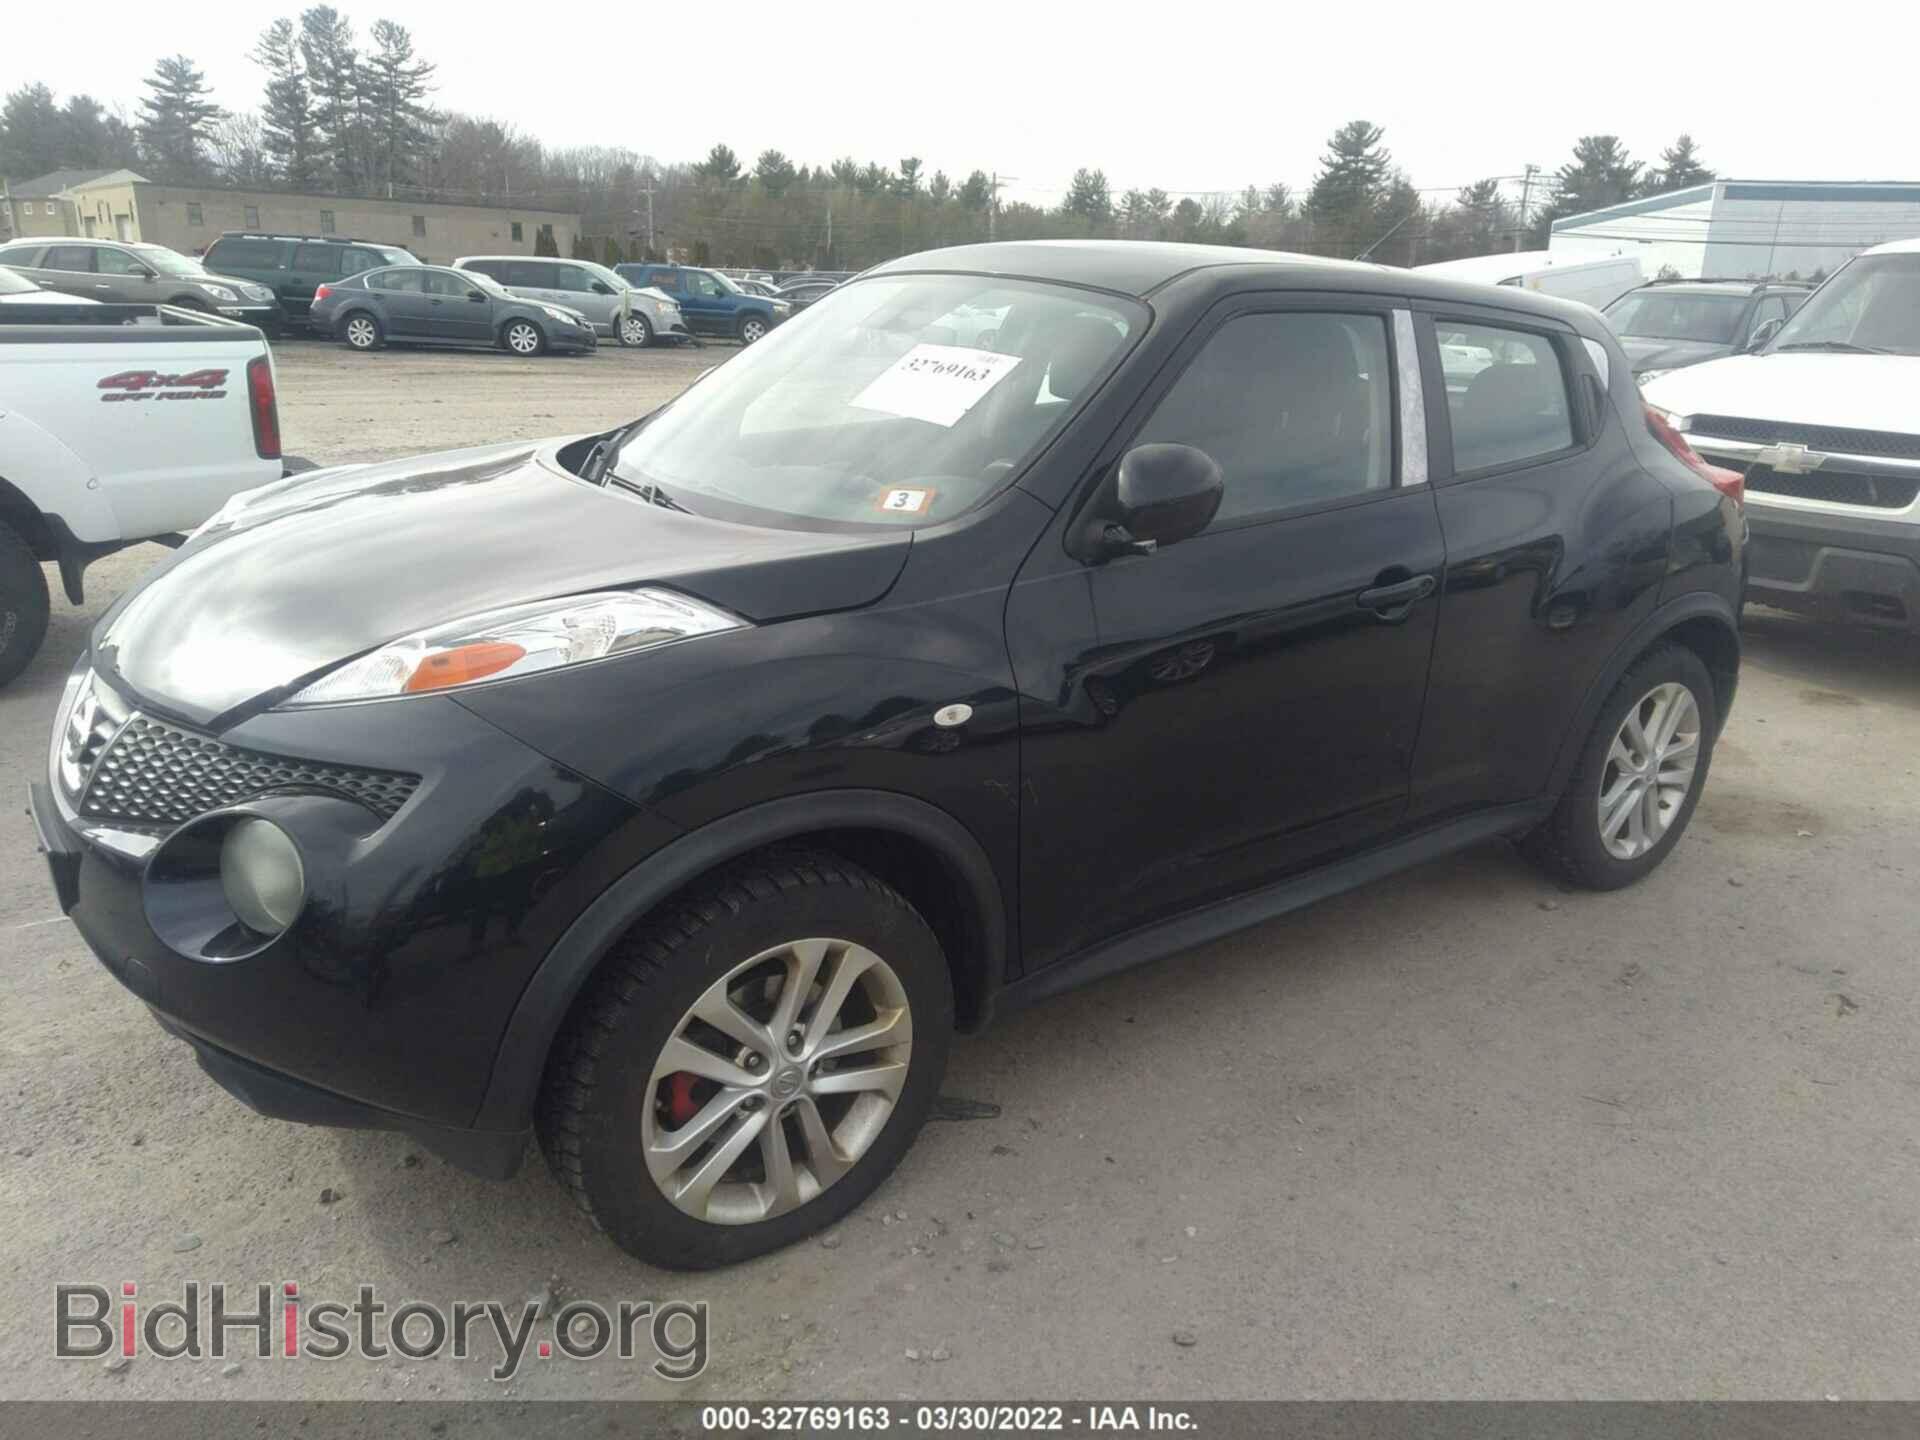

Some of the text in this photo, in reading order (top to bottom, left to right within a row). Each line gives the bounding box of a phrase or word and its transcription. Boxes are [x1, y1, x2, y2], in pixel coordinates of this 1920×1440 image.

[900, 357, 991, 381] 32769163
[101, 390, 228, 402] OFF ROAD
[893, 492, 910, 509] 3
